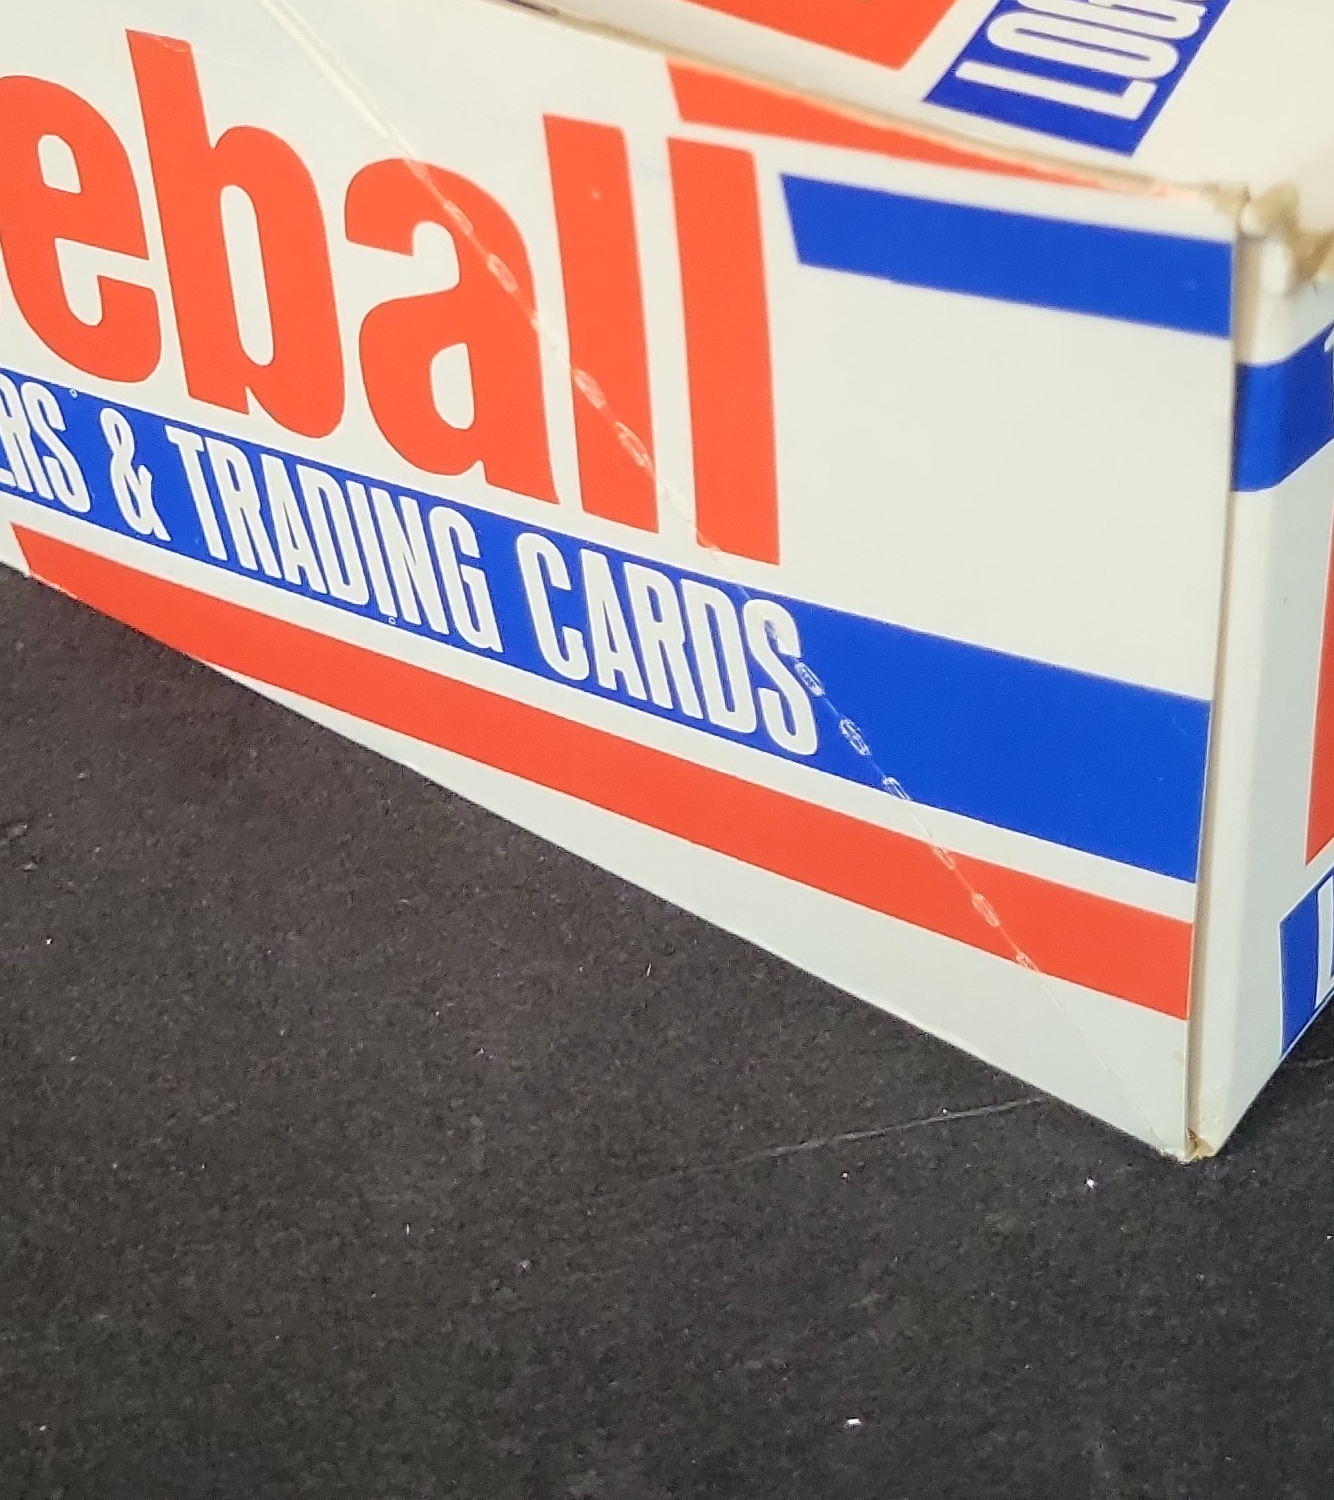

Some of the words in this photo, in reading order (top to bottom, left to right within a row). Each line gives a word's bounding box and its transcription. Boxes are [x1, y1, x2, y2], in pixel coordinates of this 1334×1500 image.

[100, 407, 170, 542] &
[166, 424, 504, 653] TRADING
[516, 532, 821, 757] CARDS
